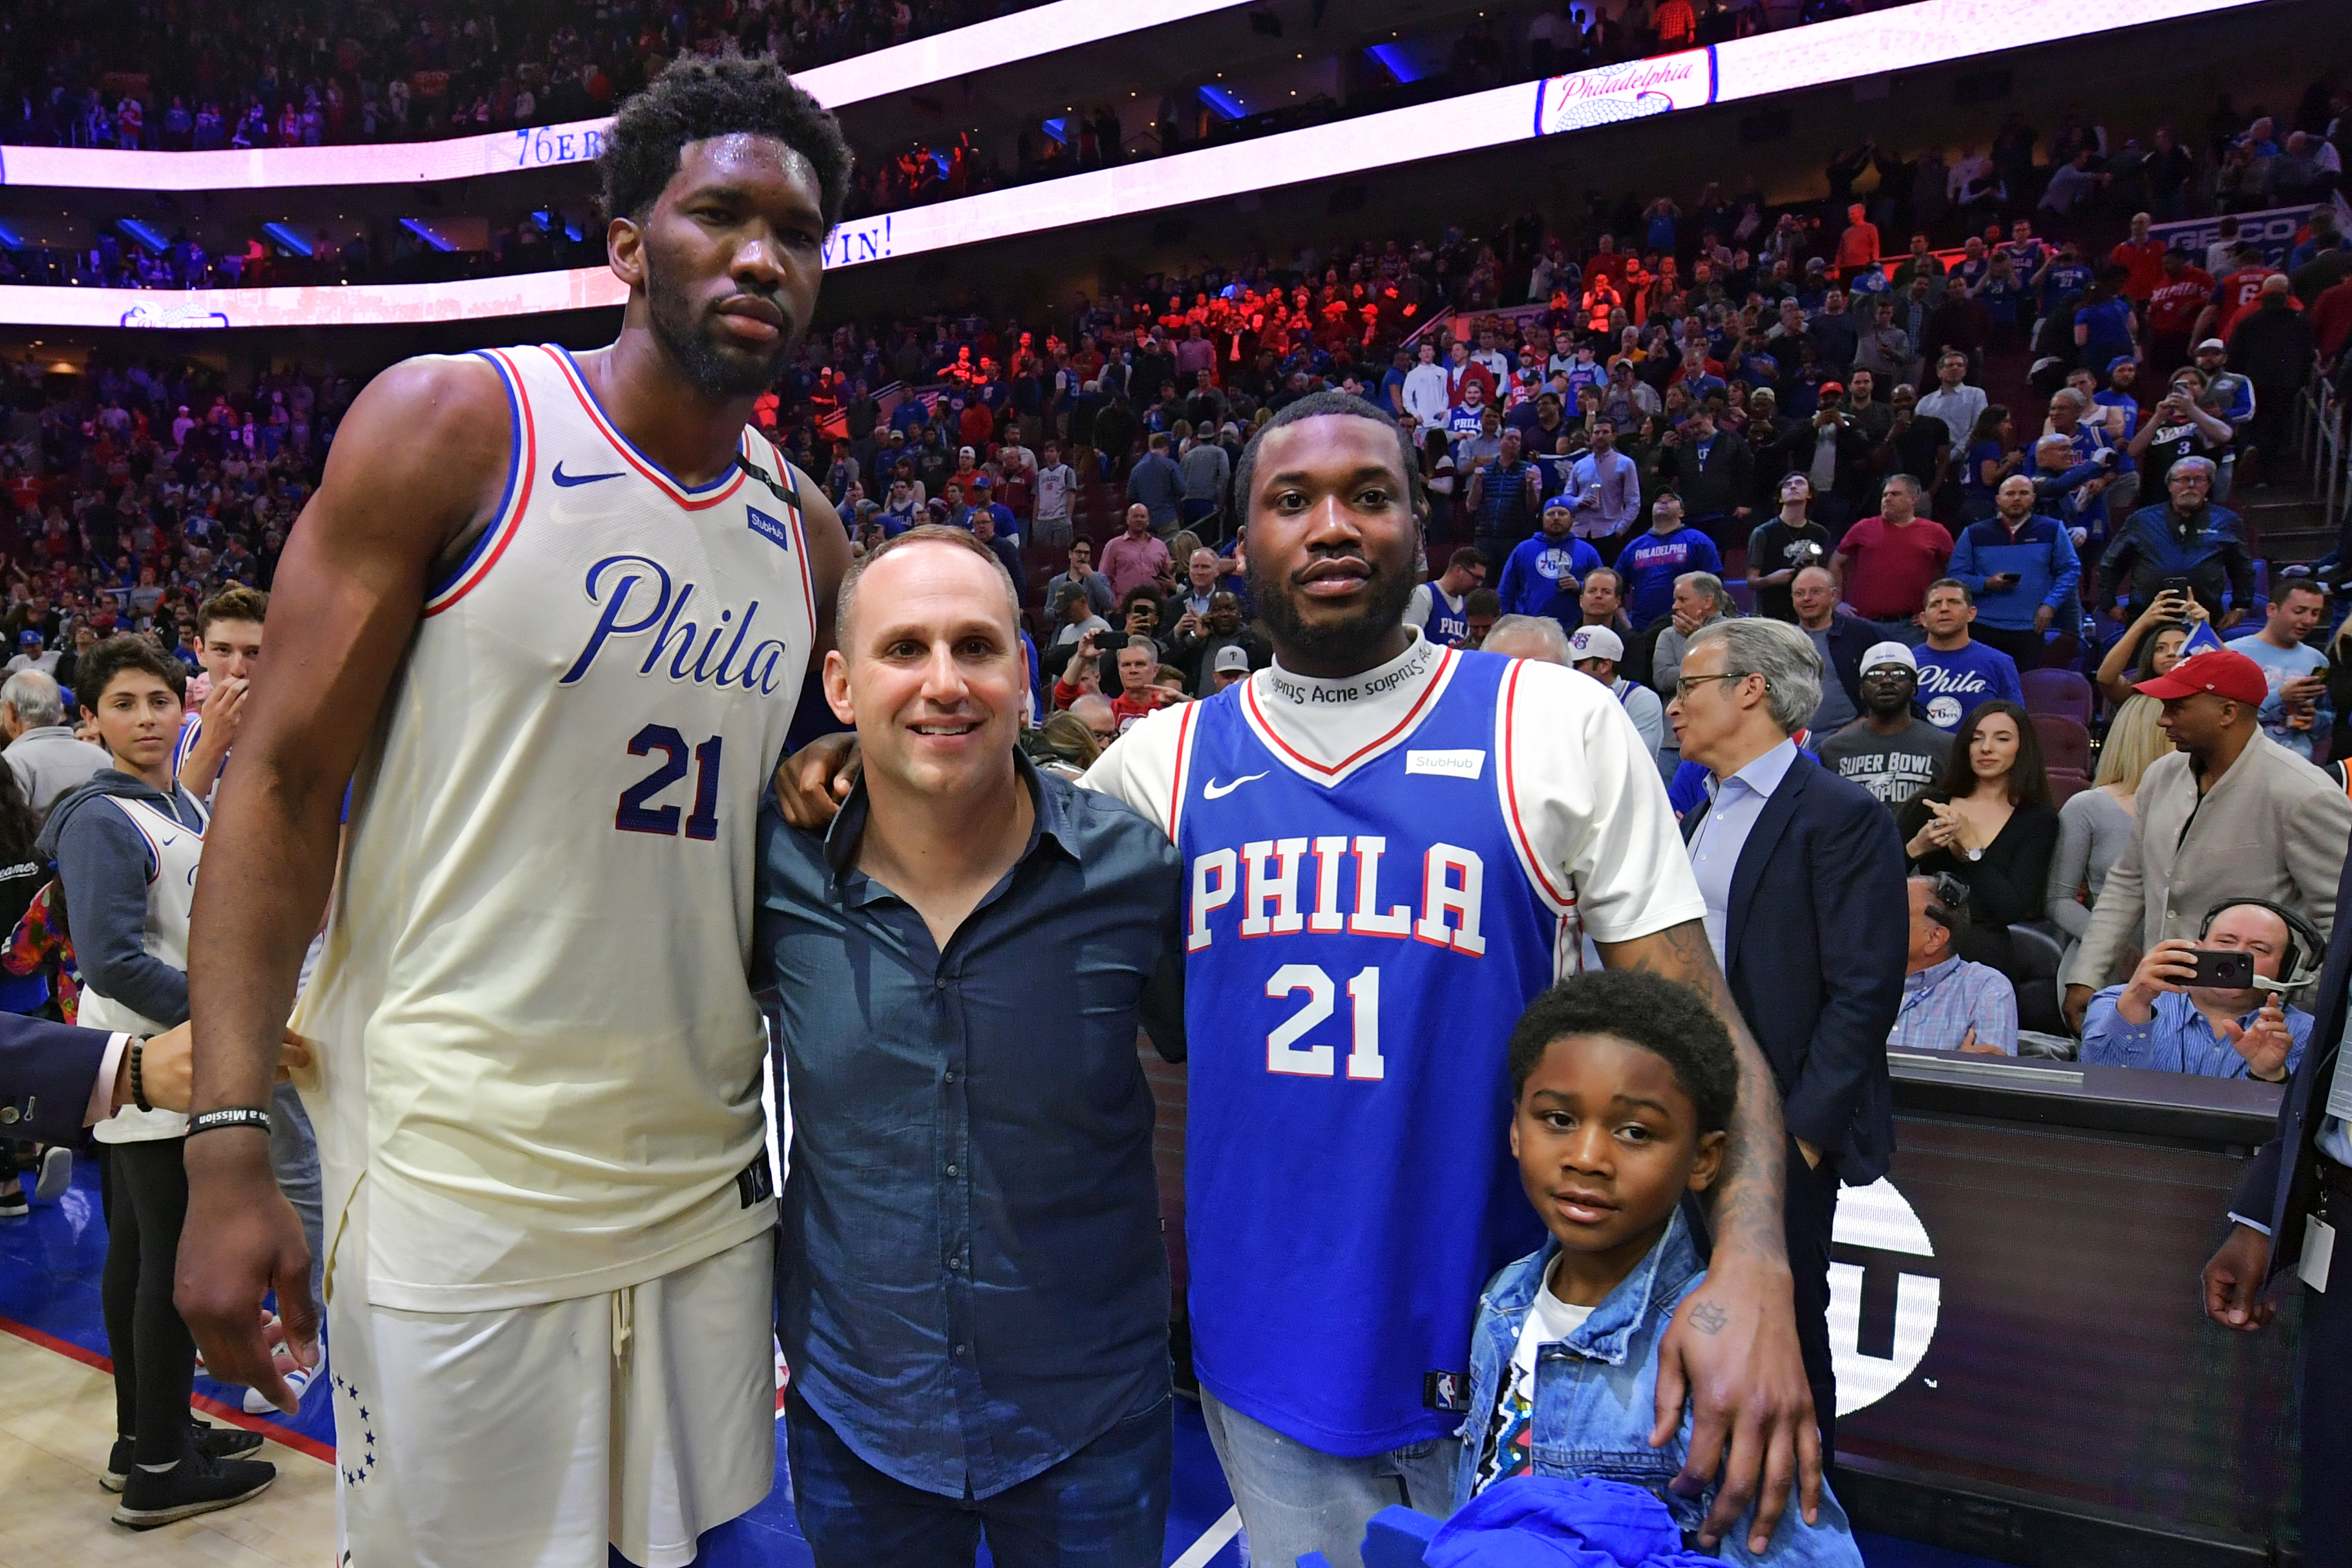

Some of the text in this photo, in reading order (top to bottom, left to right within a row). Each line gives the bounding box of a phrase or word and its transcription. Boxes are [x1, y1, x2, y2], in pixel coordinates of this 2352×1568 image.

[1557, 61, 1693, 112] Philadelphia
[516, 125, 611, 165] 76ER
[2168, 218, 2296, 250] GECO
[2177, 441, 2190, 455] 3
[751, 513, 784, 540] StubHub
[1635, 543, 1687, 561] PHILADELPHIA
[557, 551, 787, 697] Phila
[1439, 617, 1465, 640] PHIL
[1229, 652, 1238, 661] P
[1311, 685, 1359, 703] Acne
[1365, 659, 1425, 696] Studios
[1917, 664, 1987, 694] Phila
[1415, 756, 1473, 769] StubHub
[1839, 752, 1933, 777] SUPER BOWL
[615, 722, 723, 841] 21
[1186, 835, 1486, 959] PHILA
[1266, 964, 1384, 1081] 21
[199, 1110, 247, 1124] Mission
